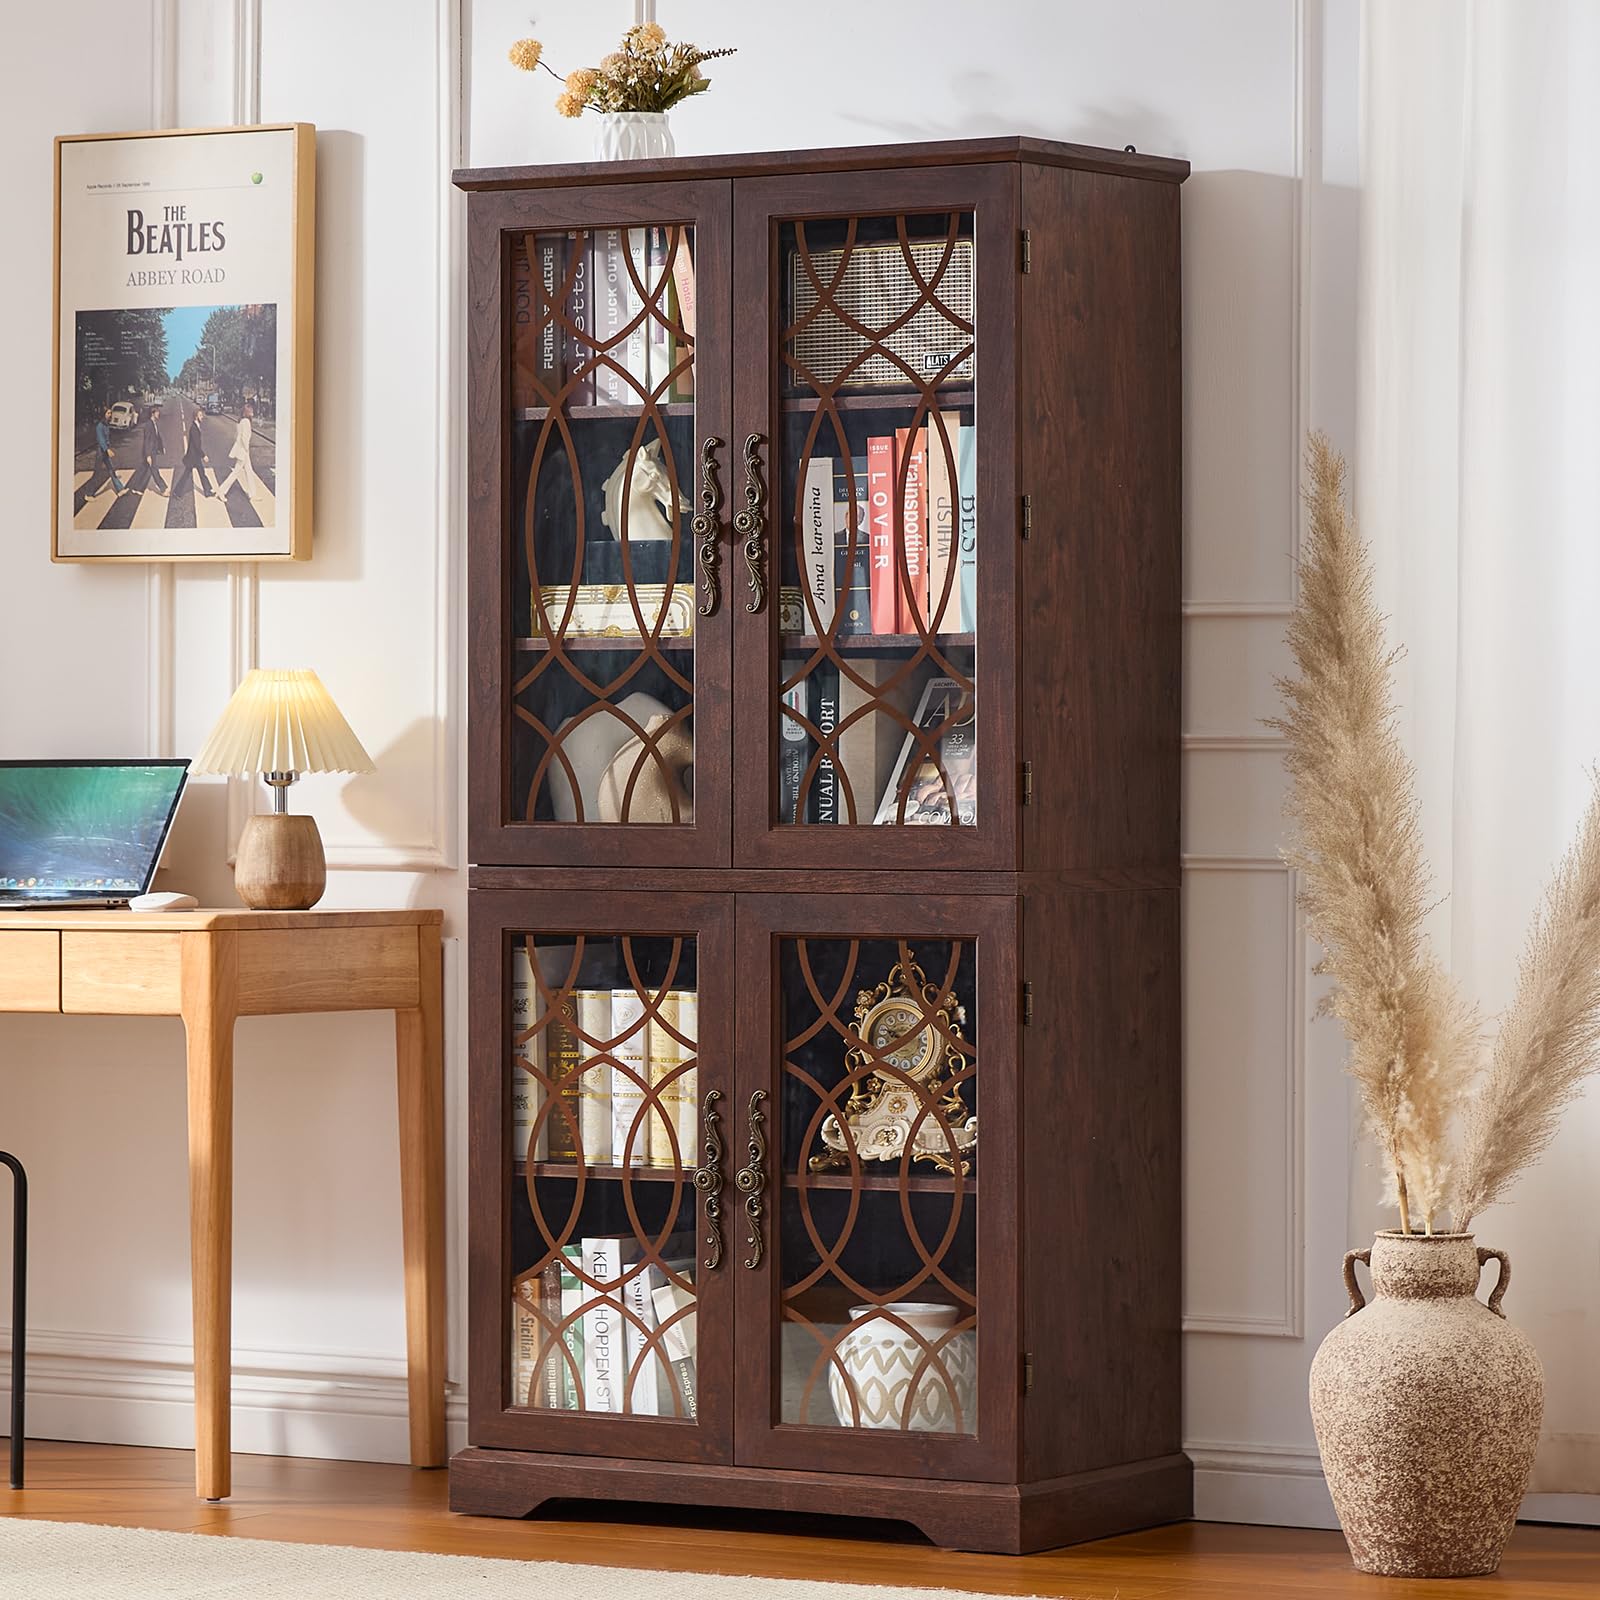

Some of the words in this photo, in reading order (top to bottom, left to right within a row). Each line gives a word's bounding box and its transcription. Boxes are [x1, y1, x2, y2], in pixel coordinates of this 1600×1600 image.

[163, 205, 186, 221] THE
[126, 209, 226, 261] BEATLES
[126, 269, 178, 287] ABBEY
[181, 268, 226, 285] ROAD
[608, 254, 618, 283] OUT
[515, 279, 530, 323] DON
[608, 287, 618, 325] LUCK
[681, 277, 694, 312] Hotels
[544, 304, 553, 369] FURNIT
[631, 327, 641, 359] ARTS
[608, 373, 618, 400] HEY
[872, 472, 889, 569] LOVER
[904, 451, 924, 576] Trainspotting
[812, 563, 826, 604] Anna
[819, 698, 833, 770] RORT
[948, 733, 964, 745] 33
[819, 773, 833, 824] NUAL
[918, 811, 976, 825] COMO
[520, 1316, 535, 1359] Sicilian
[595, 1309, 610, 1382] HOPPEN
[679, 1362, 693, 1396] Express
[687, 1396, 697, 1418] Expo
